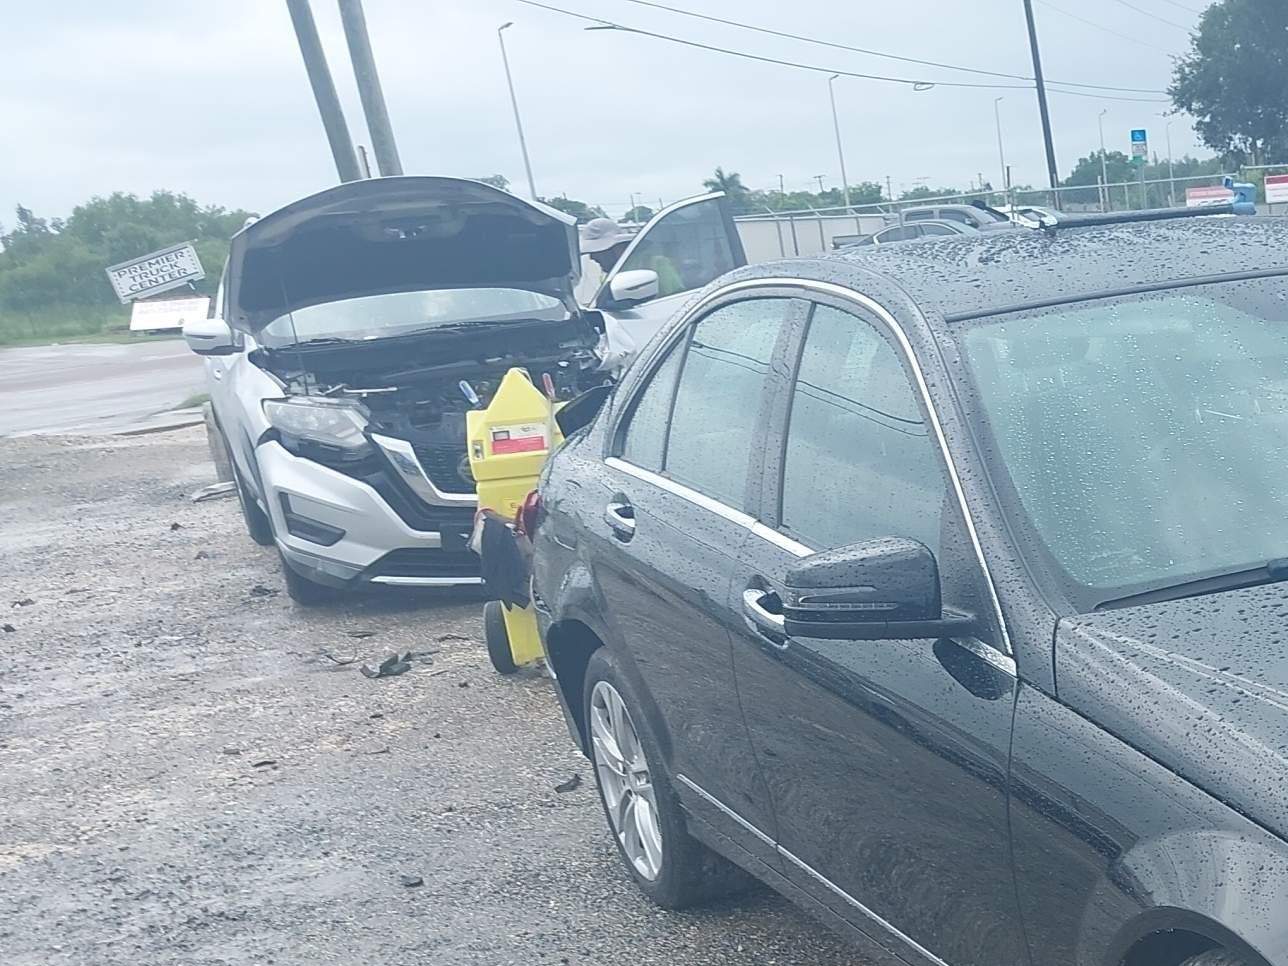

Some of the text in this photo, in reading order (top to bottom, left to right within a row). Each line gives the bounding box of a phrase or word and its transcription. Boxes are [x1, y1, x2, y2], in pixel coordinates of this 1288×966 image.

[116, 251, 185, 279] PREMIER
[129, 261, 181, 283] TRUCK
[128, 268, 188, 292] CENTER
